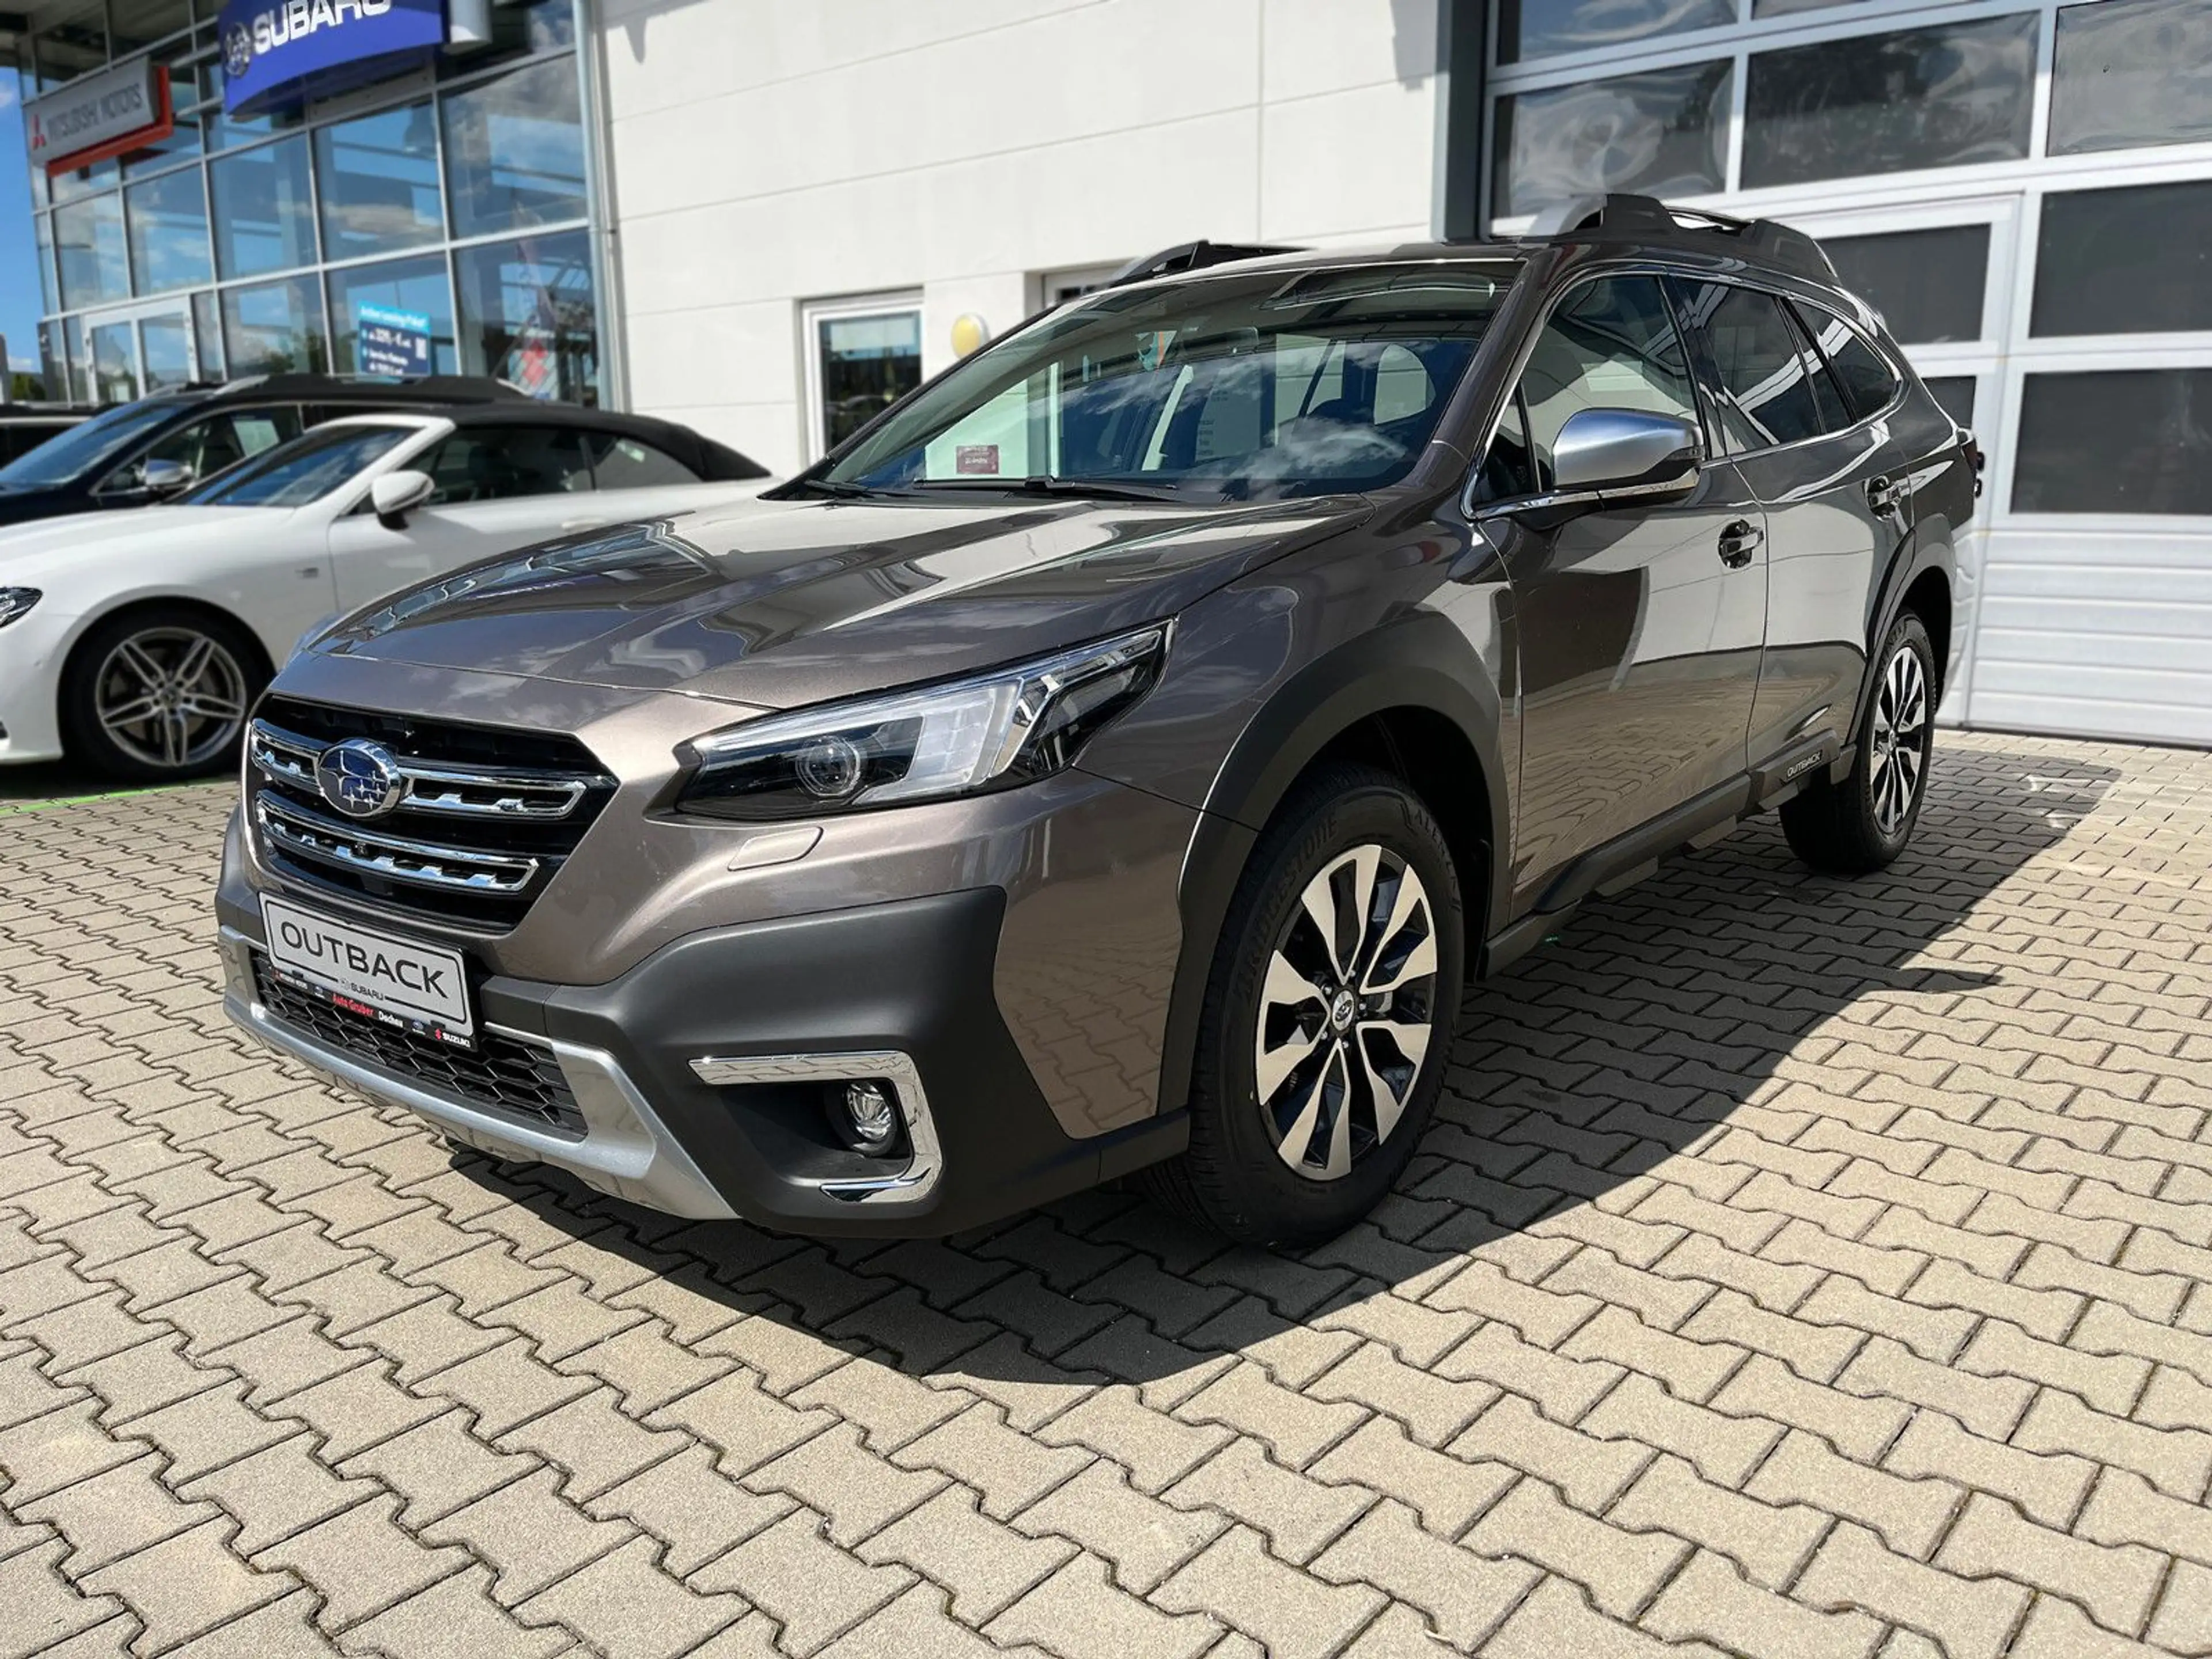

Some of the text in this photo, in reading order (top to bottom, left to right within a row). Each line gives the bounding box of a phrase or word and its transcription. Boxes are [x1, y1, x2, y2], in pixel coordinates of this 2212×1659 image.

[1787, 752, 1820, 777] OUTBACK
[281, 921, 449, 999] OUTBACK
[351, 982, 385, 1001] SUBARU
[442, 1032, 471, 1048] SUZUKI
